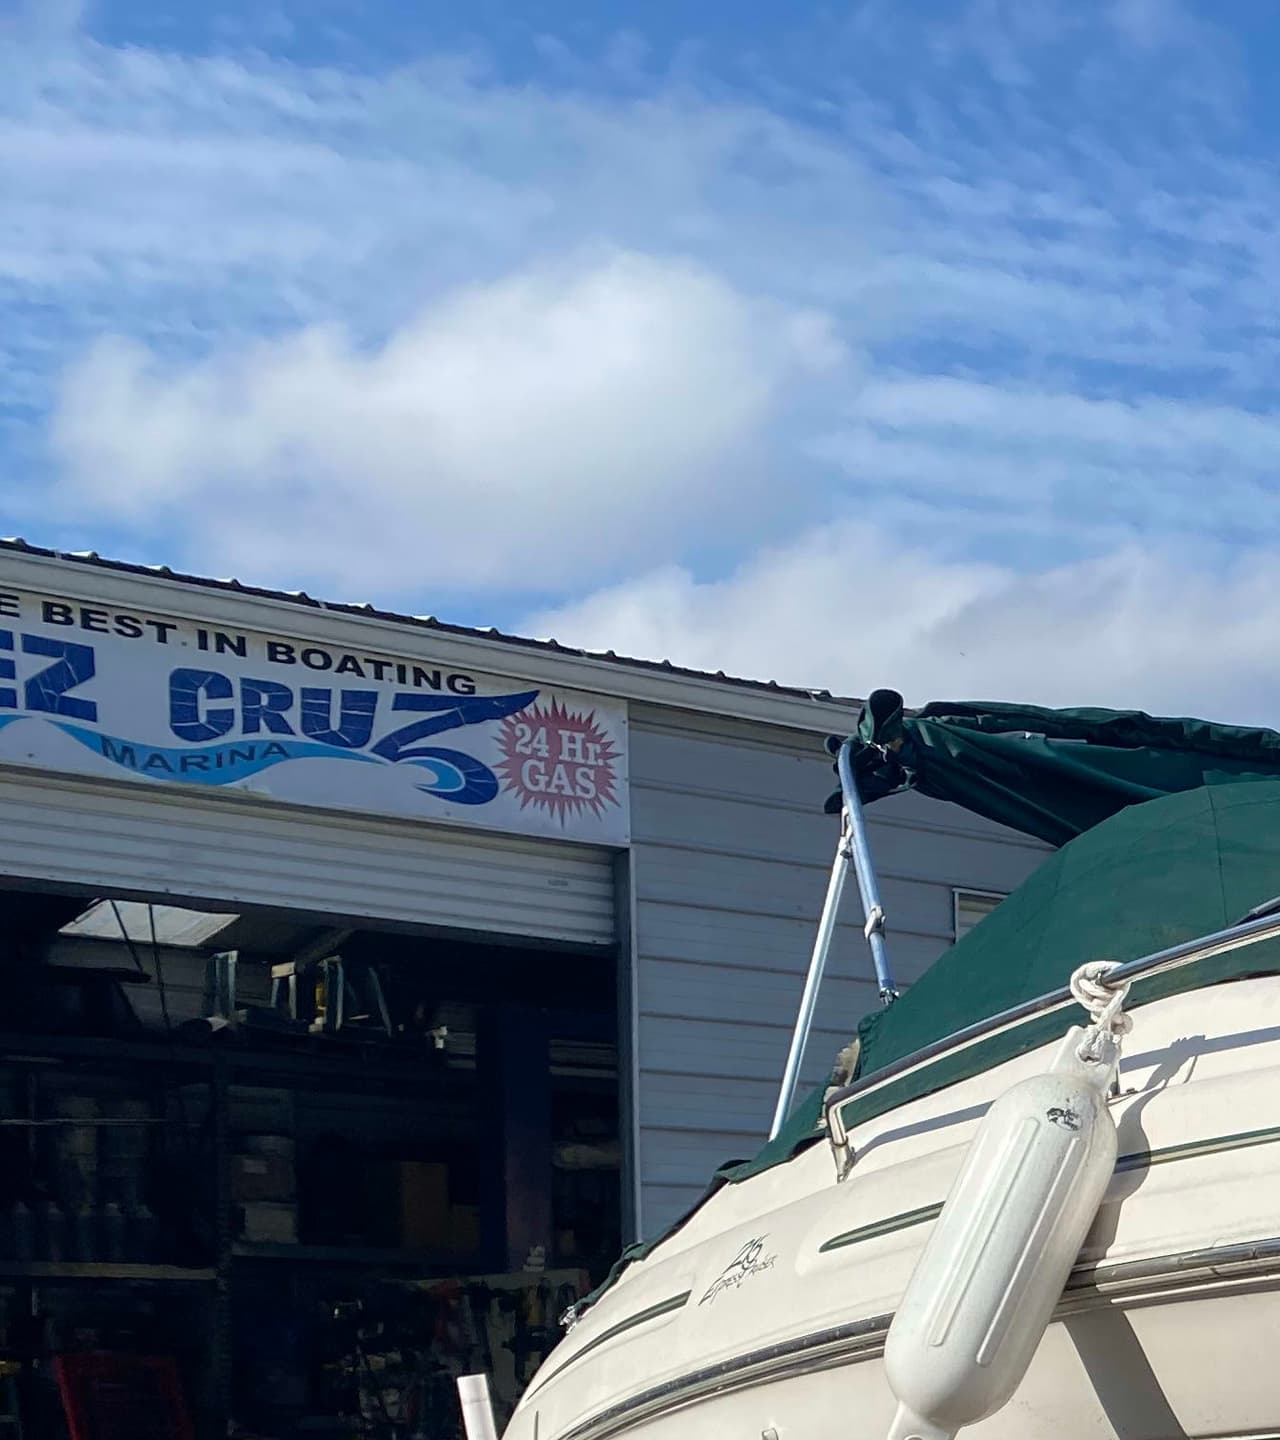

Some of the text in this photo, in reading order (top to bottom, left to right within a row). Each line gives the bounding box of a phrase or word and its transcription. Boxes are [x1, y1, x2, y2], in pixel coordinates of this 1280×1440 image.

[41, 601, 177, 644] BEST
[197, 629, 248, 657] IN
[266, 641, 476, 695] BOATING
[101, 734, 290, 773] MARINA
[168, 667, 540, 804] CRUZ
[514, 723, 549, 757] 24
[521, 759, 596, 799] GAS
